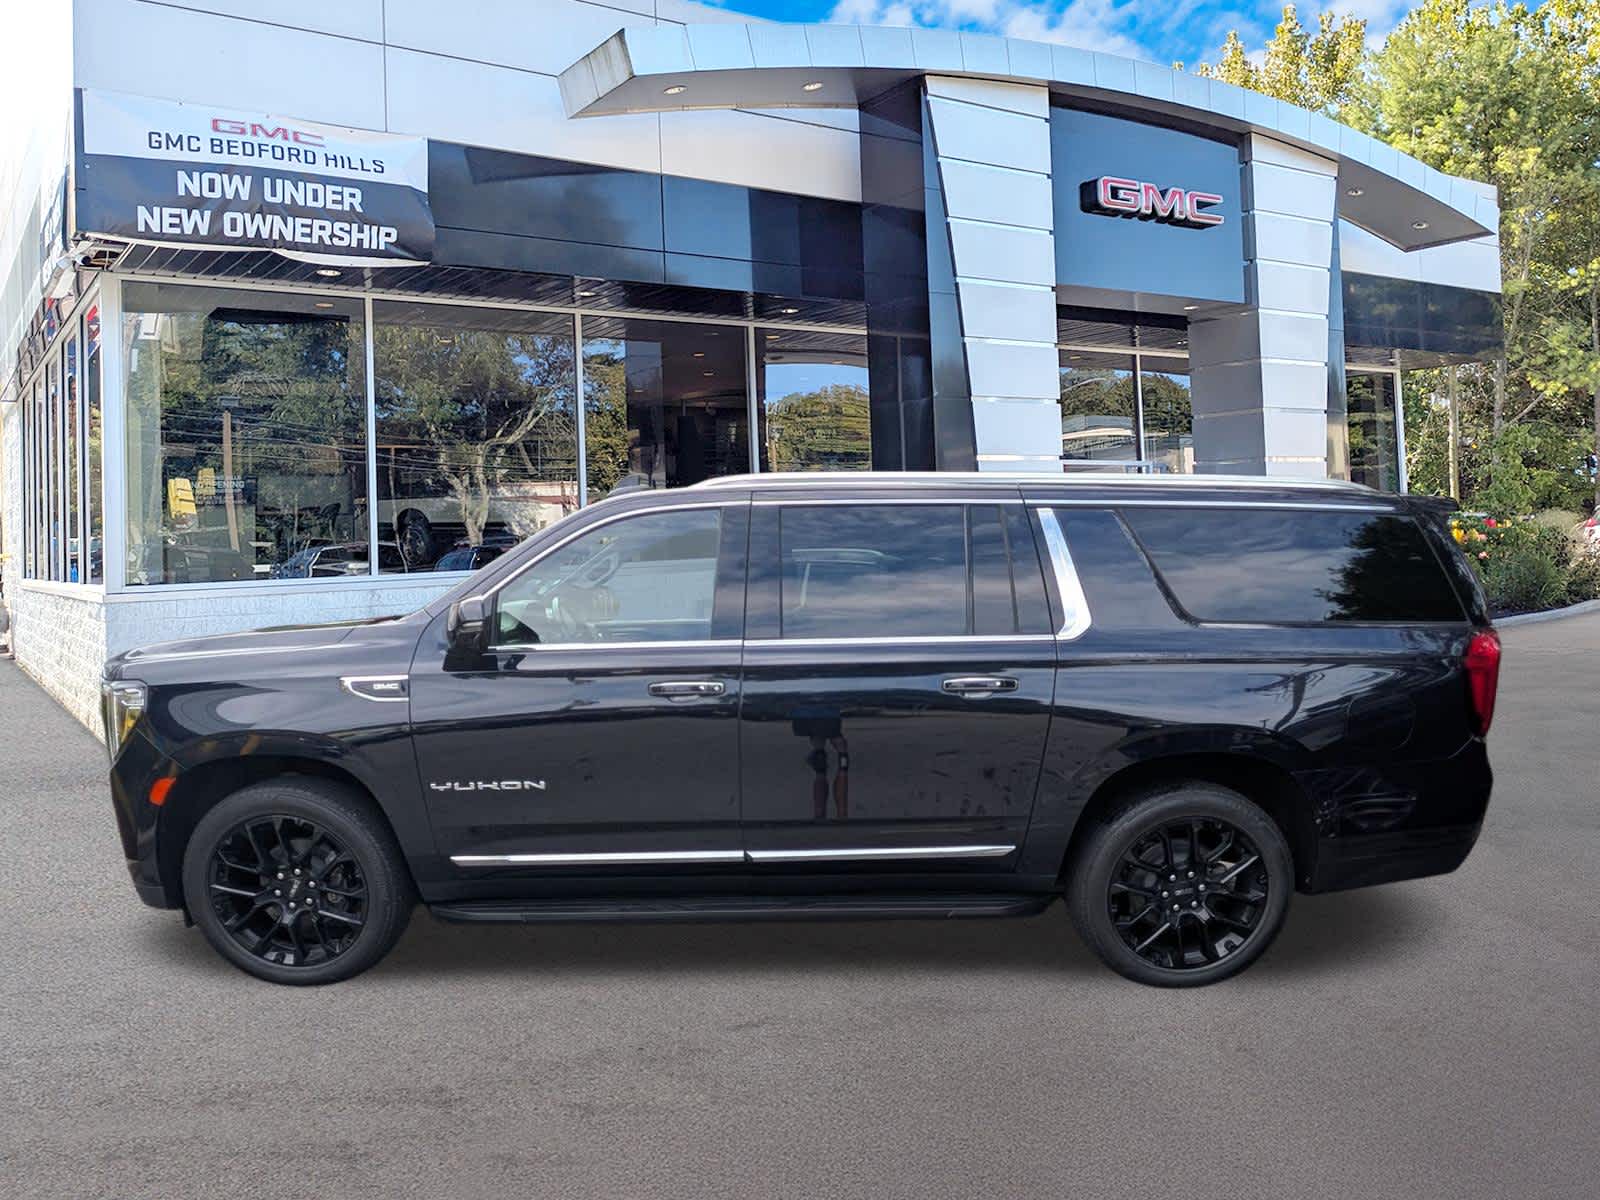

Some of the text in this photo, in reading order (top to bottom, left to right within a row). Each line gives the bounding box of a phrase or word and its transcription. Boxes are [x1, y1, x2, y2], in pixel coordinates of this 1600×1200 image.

[148, 131, 385, 174] GMC BEDFORD HILLS
[210, 118, 326, 148] GMC
[177, 170, 364, 213] NOW UNDER
[1096, 175, 1225, 225] GMC
[136, 205, 398, 251] NEW OWNERSHIP
[430, 780, 546, 792] YUKON
